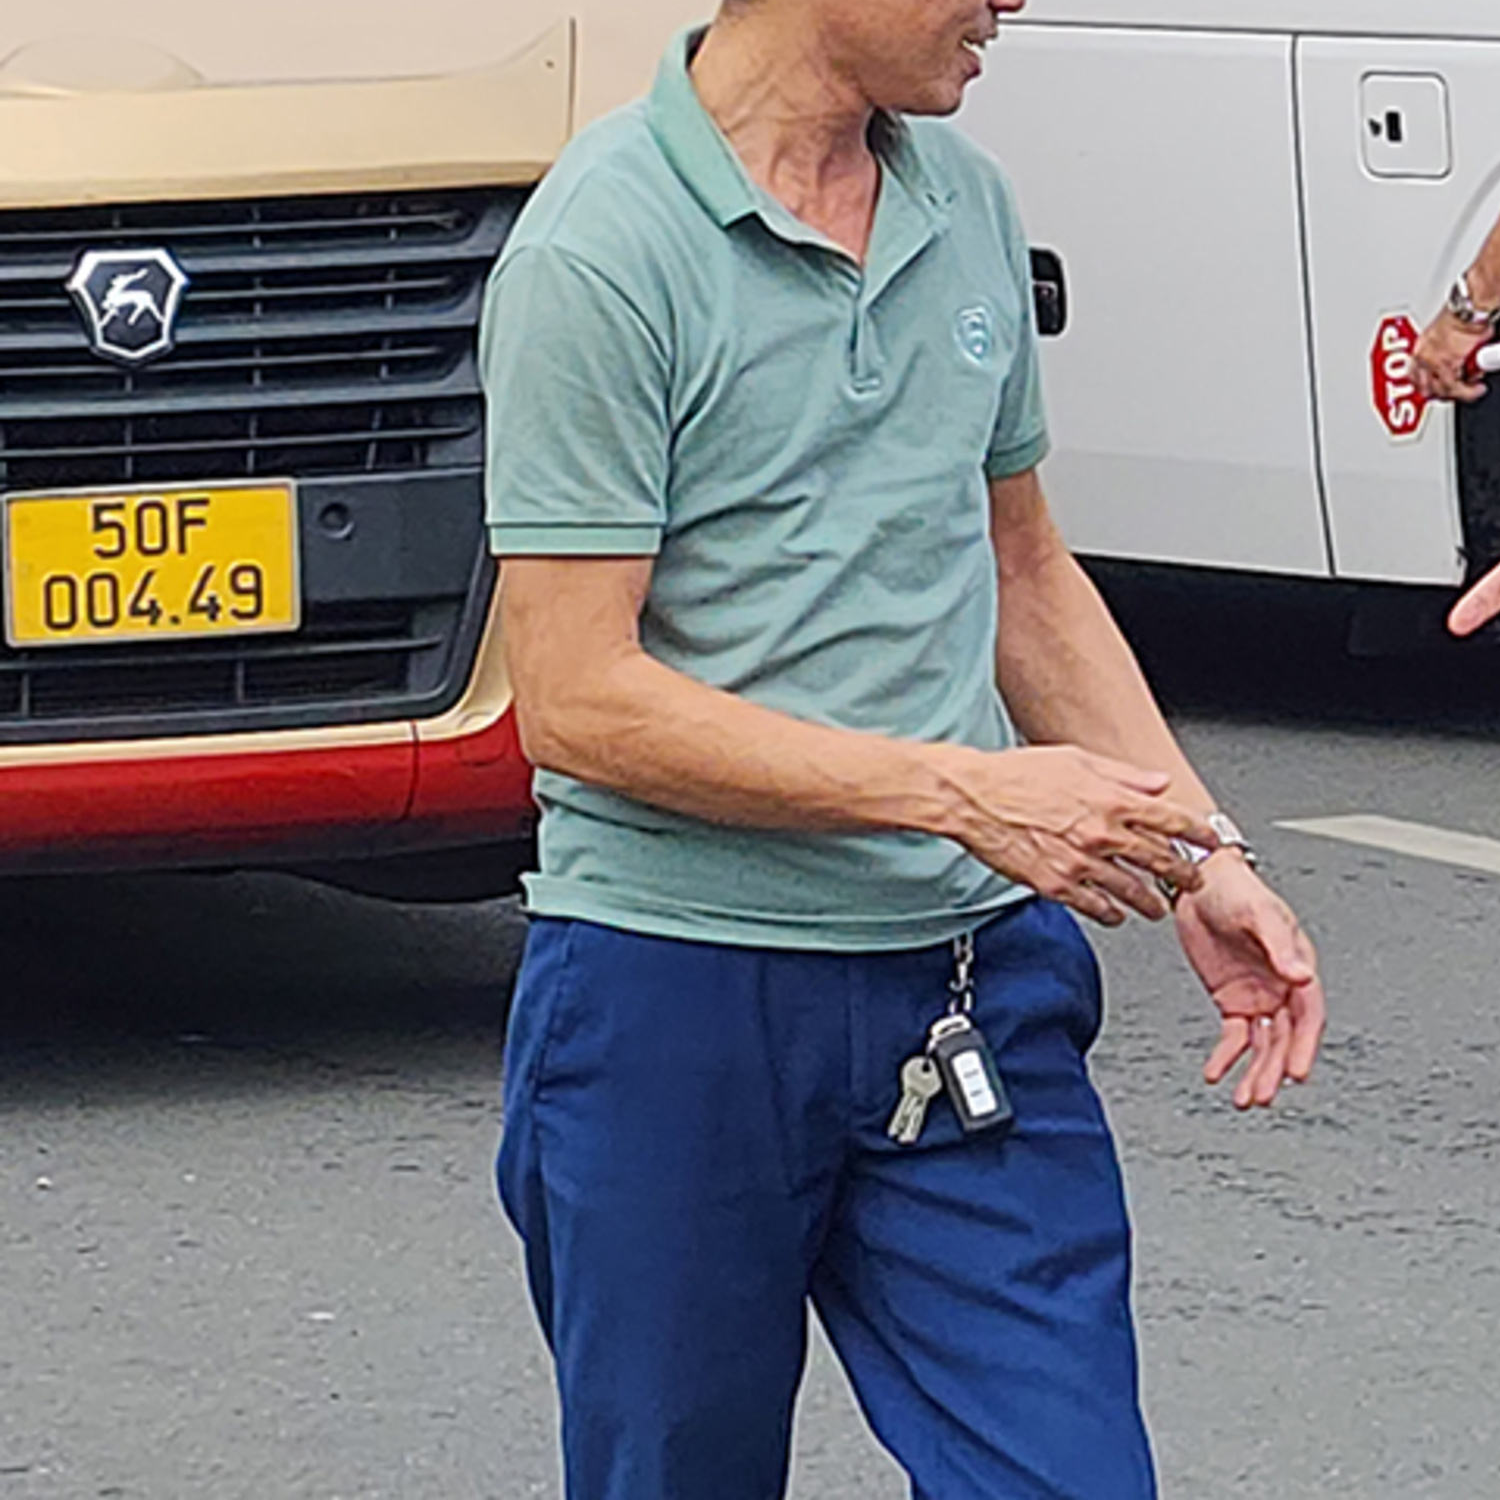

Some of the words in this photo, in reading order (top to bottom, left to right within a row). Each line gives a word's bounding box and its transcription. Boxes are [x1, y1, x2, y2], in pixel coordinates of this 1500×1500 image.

[1382, 325, 1416, 428] STOP
[92, 497, 210, 560] 50F
[43, 564, 264, 631] 004.49
